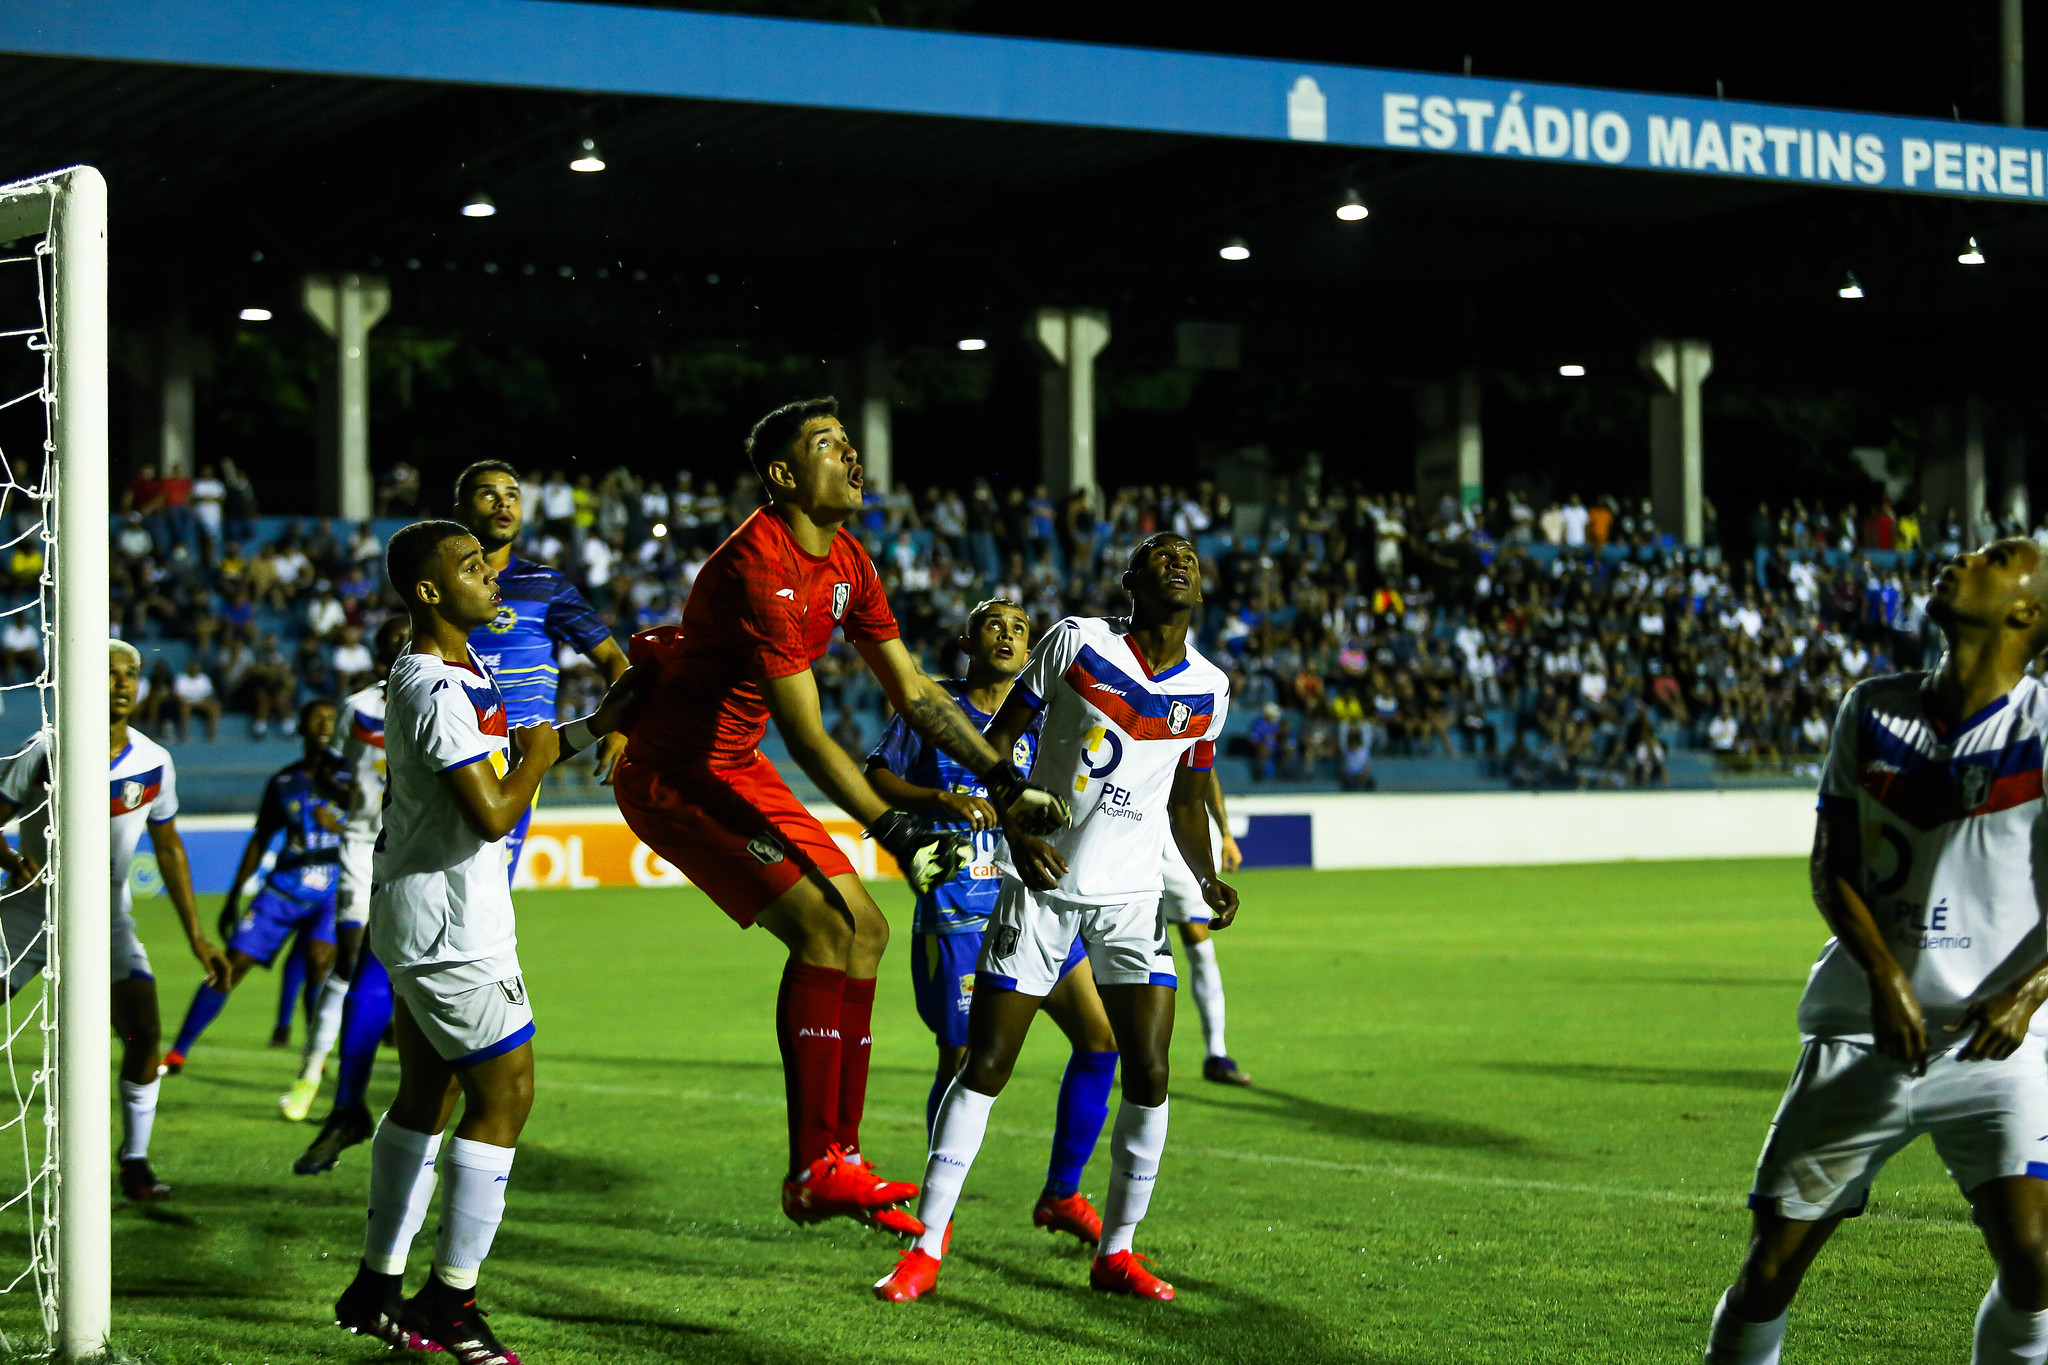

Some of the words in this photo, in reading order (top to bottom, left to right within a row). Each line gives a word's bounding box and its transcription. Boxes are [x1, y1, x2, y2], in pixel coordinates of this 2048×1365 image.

[1383, 89, 1632, 164] ESTÁDIO
[1648, 114, 1886, 185] MARTINS
[1902, 136, 2048, 197] PEREI
[513, 834, 599, 890] OL
